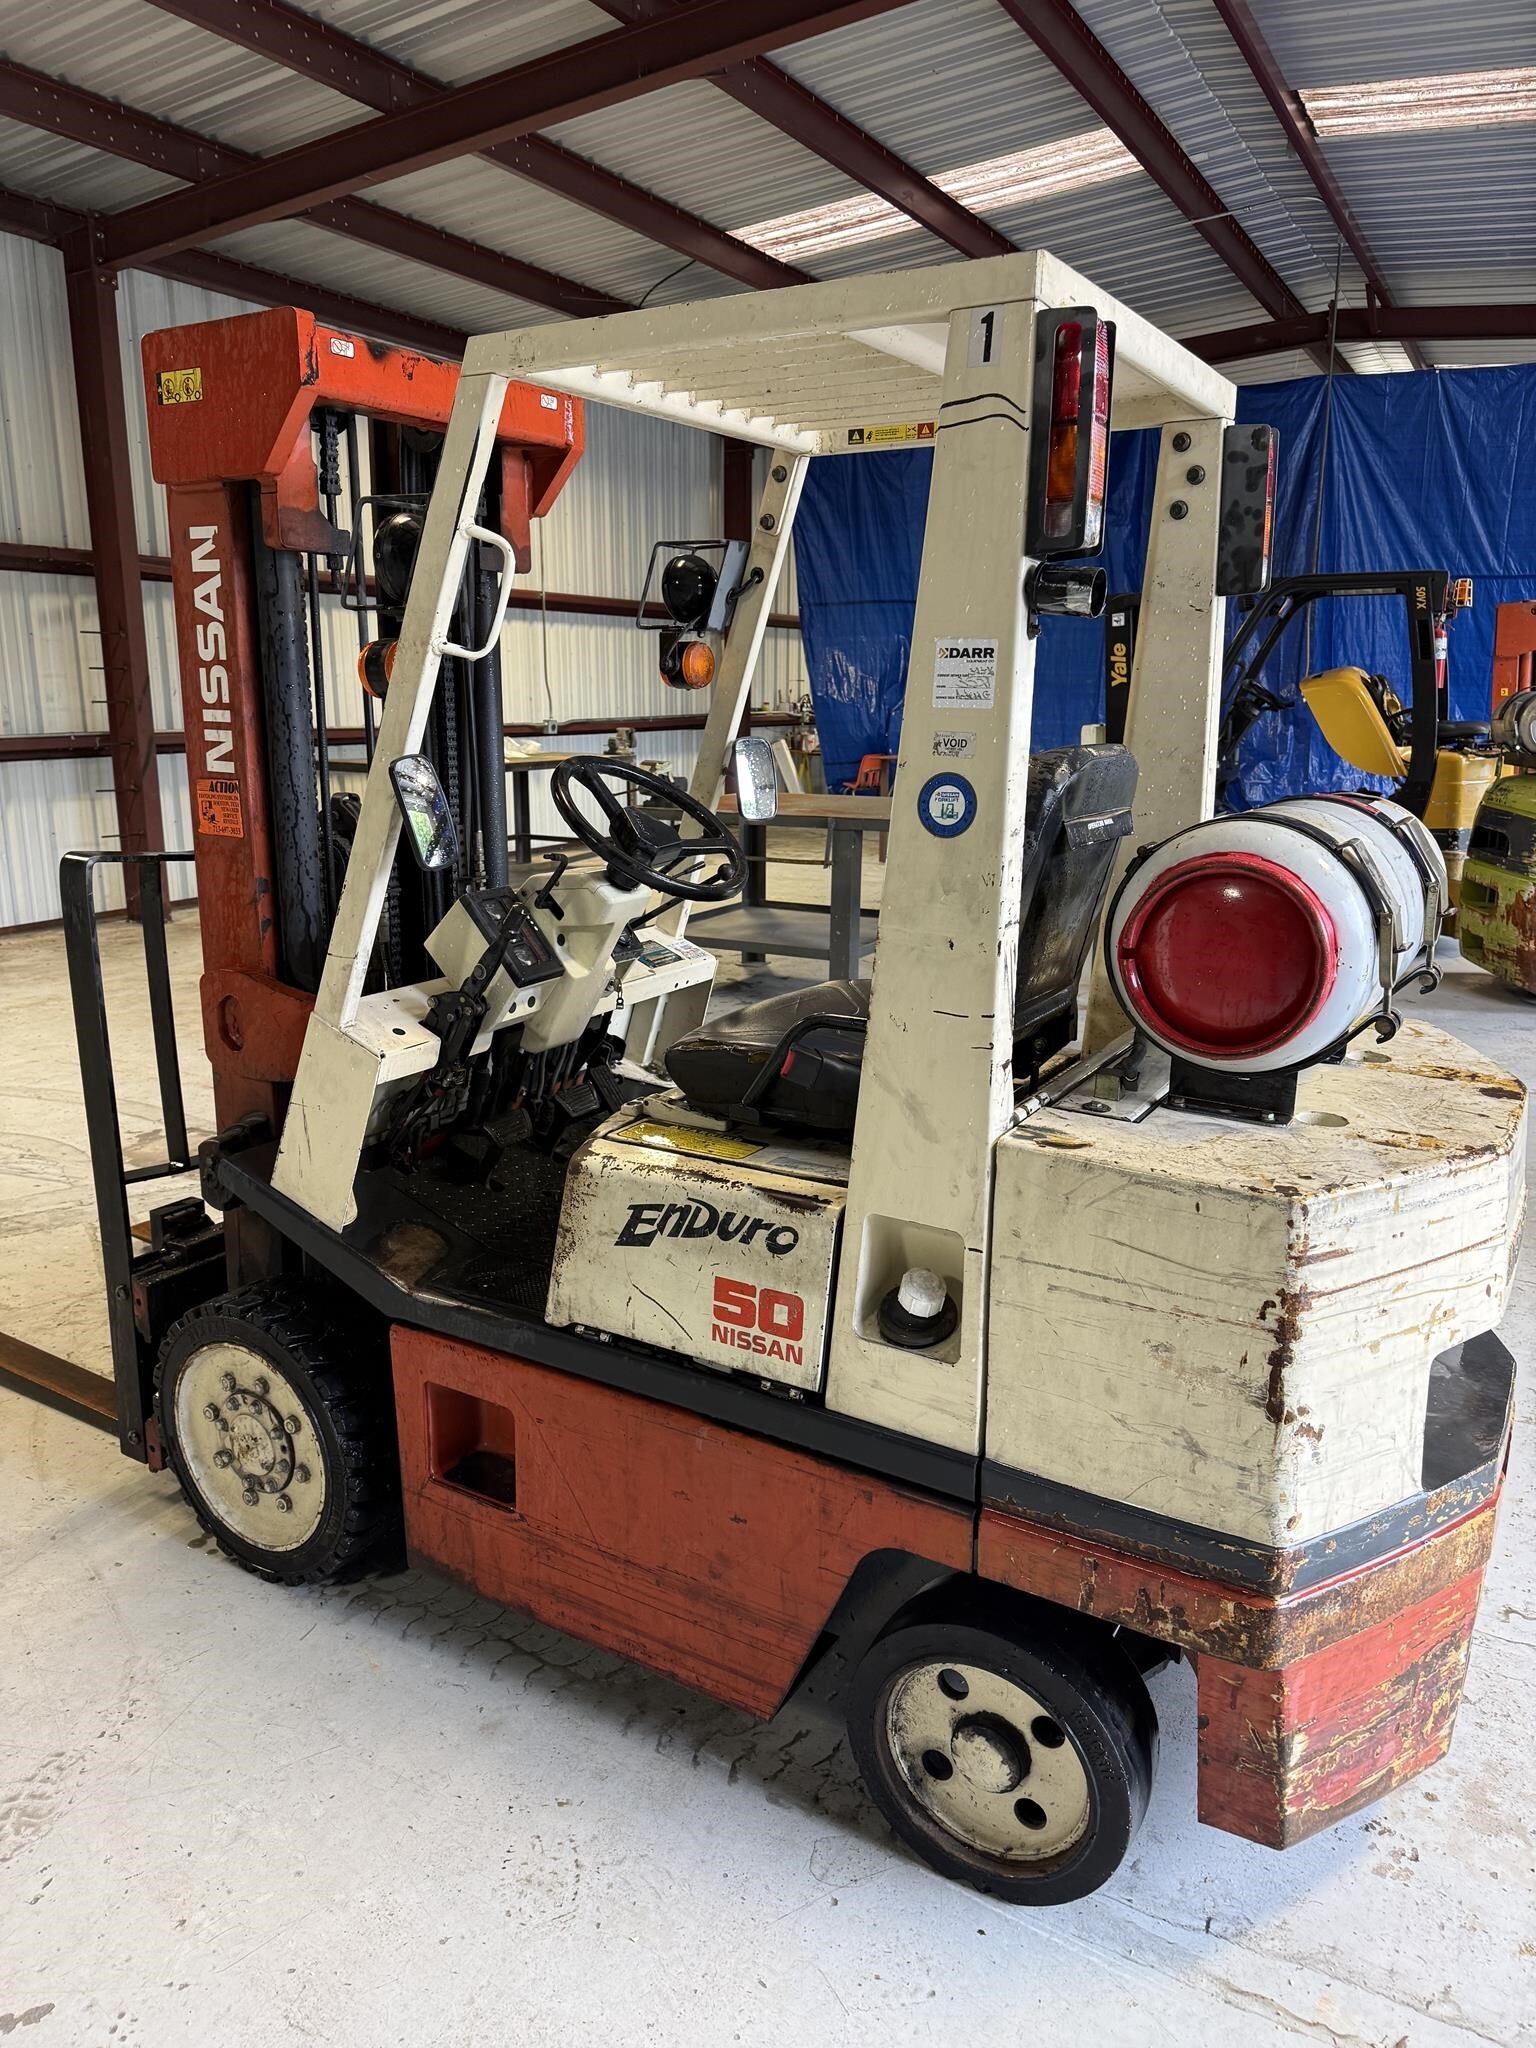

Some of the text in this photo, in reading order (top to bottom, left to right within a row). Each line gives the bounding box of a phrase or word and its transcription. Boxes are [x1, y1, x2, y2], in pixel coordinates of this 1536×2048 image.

[981, 311, 994, 363] 1
[189, 525, 236, 774] NISSAN
[949, 647, 995, 659] DARR
[1111, 643, 1127, 687] Yale
[943, 738, 968, 749] VOID
[208, 780, 240, 794] ACTION
[712, 1275, 805, 1342] 50
[711, 1322, 803, 1367] NISSAN
